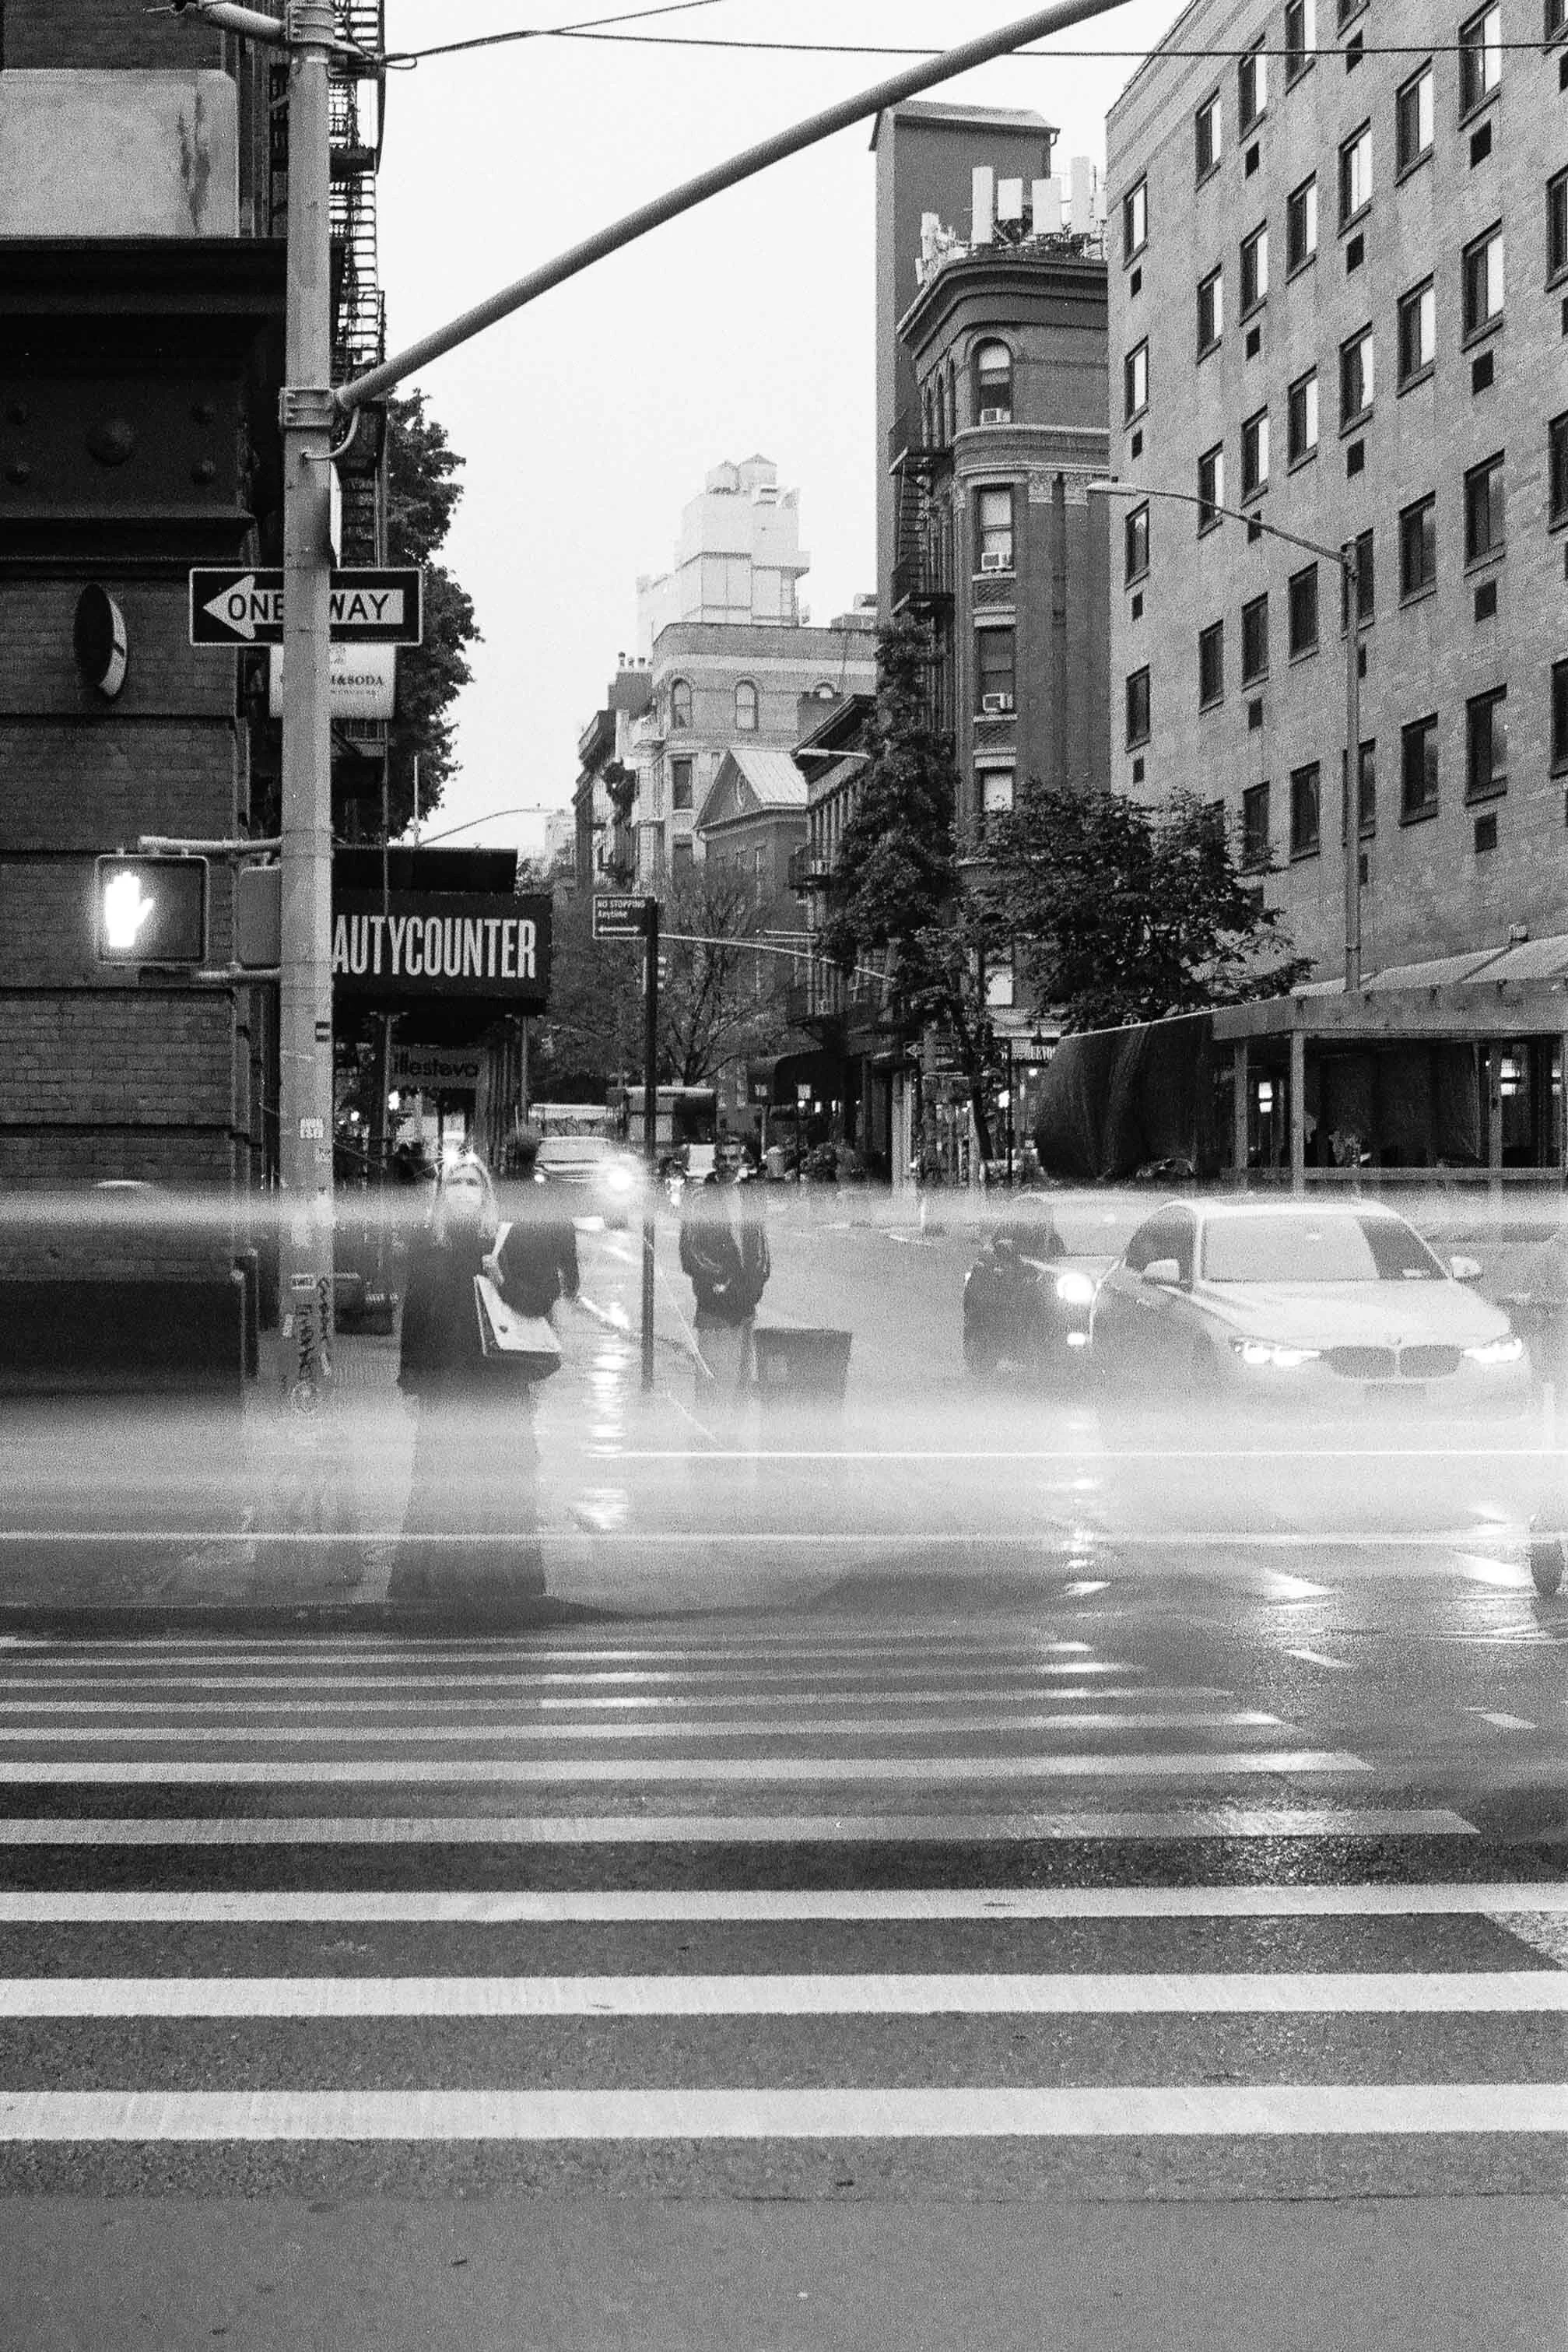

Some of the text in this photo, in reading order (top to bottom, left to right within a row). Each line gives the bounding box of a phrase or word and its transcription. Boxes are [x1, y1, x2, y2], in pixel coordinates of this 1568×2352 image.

[227, 593, 283, 621] ONE
[597, 900, 646, 908] NO STOPPING
[331, 914, 536, 978] AUTYCOUNTER
